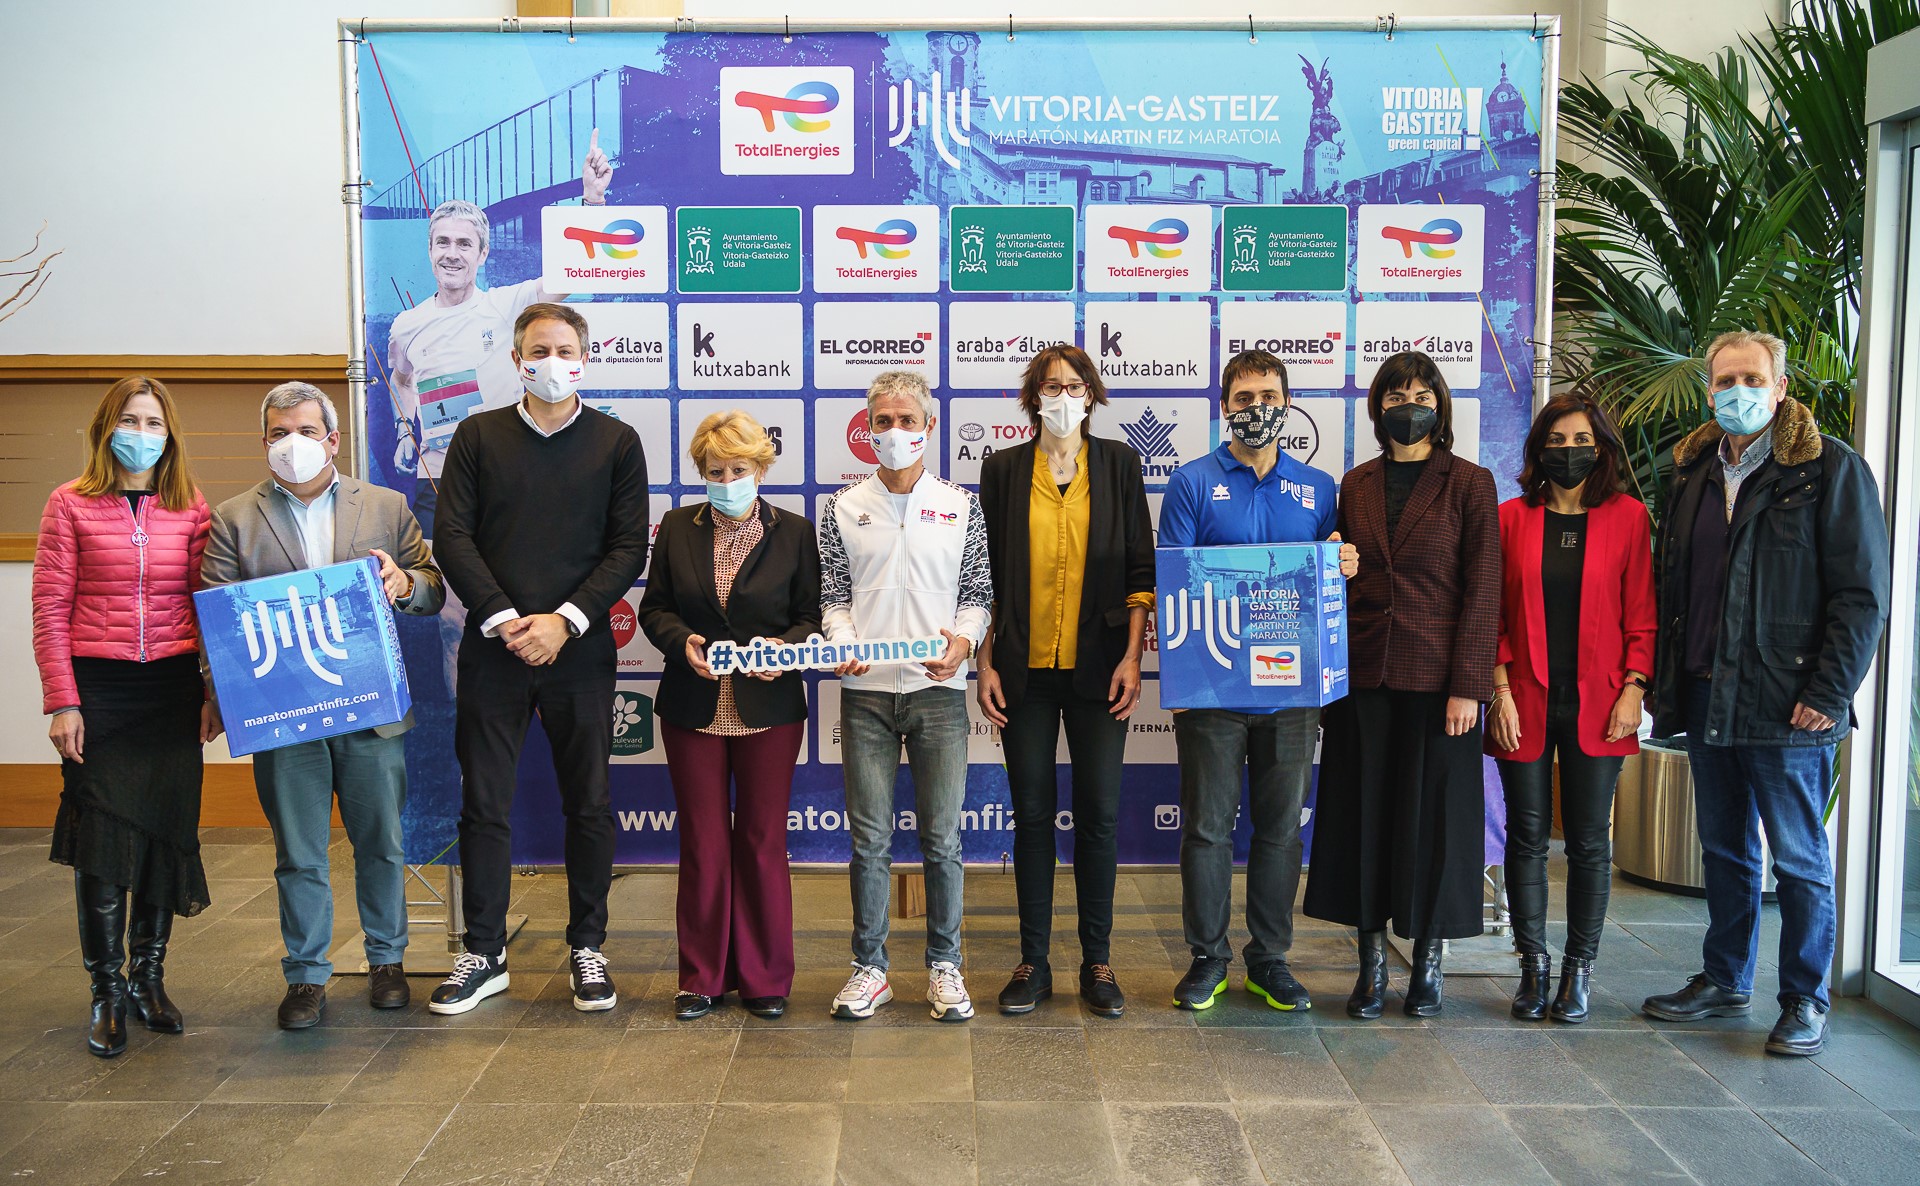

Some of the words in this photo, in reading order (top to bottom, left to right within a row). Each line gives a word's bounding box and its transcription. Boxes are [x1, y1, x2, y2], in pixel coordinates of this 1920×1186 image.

[1382, 87, 1463, 110] VITORIA
[989, 95, 1280, 122] VITORIA-GASTEIZ
[1382, 111, 1463, 135] GASTEIZ
[989, 125, 1078, 145] MARATÓN
[1083, 129, 1152, 145] MARTIN
[1158, 129, 1184, 145] FIZ
[1189, 128, 1281, 145] MARATOIA
[1388, 137, 1420, 151] green
[1423, 136, 1462, 151] capital
[734, 143, 840, 160] TotalEnergies
[722, 233, 778, 242] Ayuntamiento
[995, 232, 1052, 241] Ayuntamiento
[1268, 232, 1324, 241] Ayuntamiento
[1007, 240, 1065, 248] Vitoria-Gasteiz
[1268, 240, 1279, 248] de
[1280, 240, 1337, 248] Vitoria-Gasteiz
[722, 251, 790, 259] Vitoria-Gasteizko
[995, 250, 1063, 258] Vitoria-Gasteizko
[1268, 250, 1335, 258] Vitoria-Gasteizko
[723, 260, 746, 268] Udala
[996, 259, 1019, 267] Udala
[564, 267, 646, 281] TotalEnergies
[836, 267, 918, 281] TotalEnergies
[1107, 266, 1189, 280] TotalEnergies
[1380, 266, 1462, 280] TotalEnergies
[615, 337, 663, 354] álava
[820, 340, 843, 354] EL
[845, 339, 925, 354] CORREO
[956, 336, 1004, 353] araba
[1254, 339, 1334, 354] CORREO
[1363, 336, 1411, 353] araba
[1426, 336, 1473, 353] álava
[605, 356, 645, 364] diputación
[973, 355, 1005, 363] aldundia
[693, 360, 791, 377] kutxabank
[1100, 359, 1198, 376] kutxabank
[437, 402, 446, 417] 1
[1249, 589, 1300, 600] VITORIA
[1249, 600, 1300, 611] GASTEIZ
[1249, 611, 1297, 621] MARATÓN
[1250, 622, 1285, 630] MARTIN
[1286, 621, 1300, 630] FIZ
[1250, 631, 1299, 640] MARATOIA
[711, 637, 944, 670] #vitoriarunner
[1256, 673, 1296, 681] TotalEnergies
[244, 691, 379, 728] maratonmartinfiz.com
